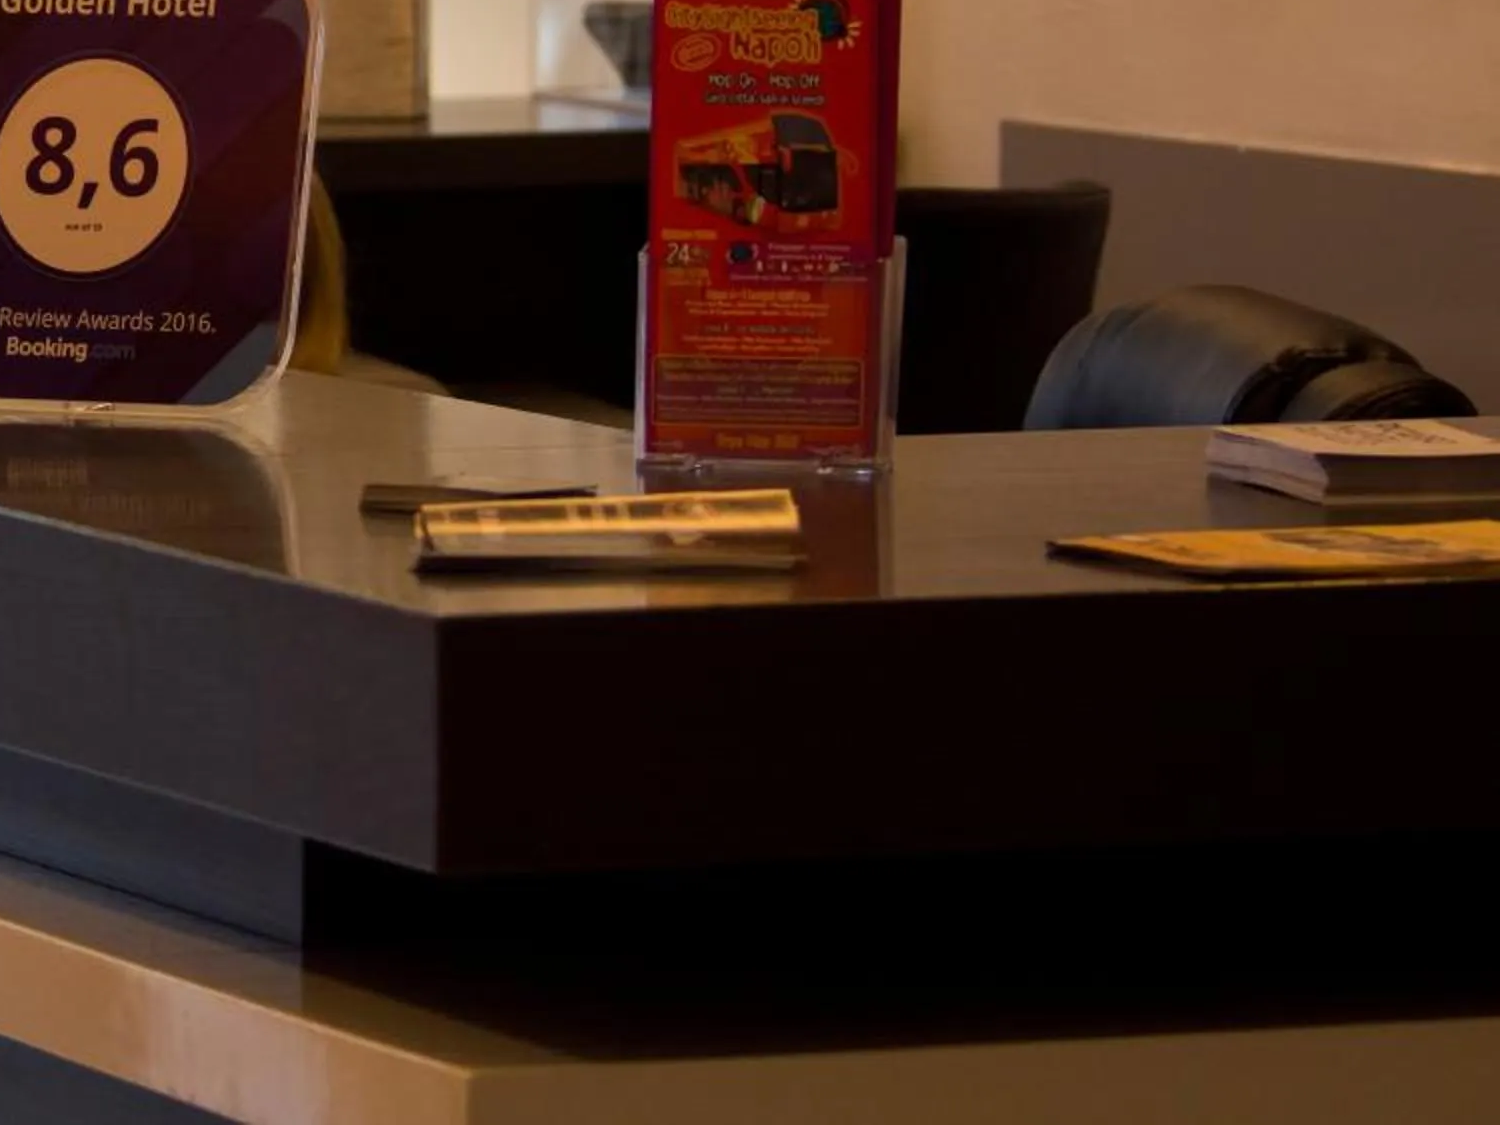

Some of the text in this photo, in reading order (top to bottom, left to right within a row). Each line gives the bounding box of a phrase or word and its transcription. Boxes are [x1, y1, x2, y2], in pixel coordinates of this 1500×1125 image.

[732, 29, 821, 64] Napoli
[24, 116, 160, 210] 8,6
[0, 307, 72, 329] Review
[76, 309, 155, 333] Awards
